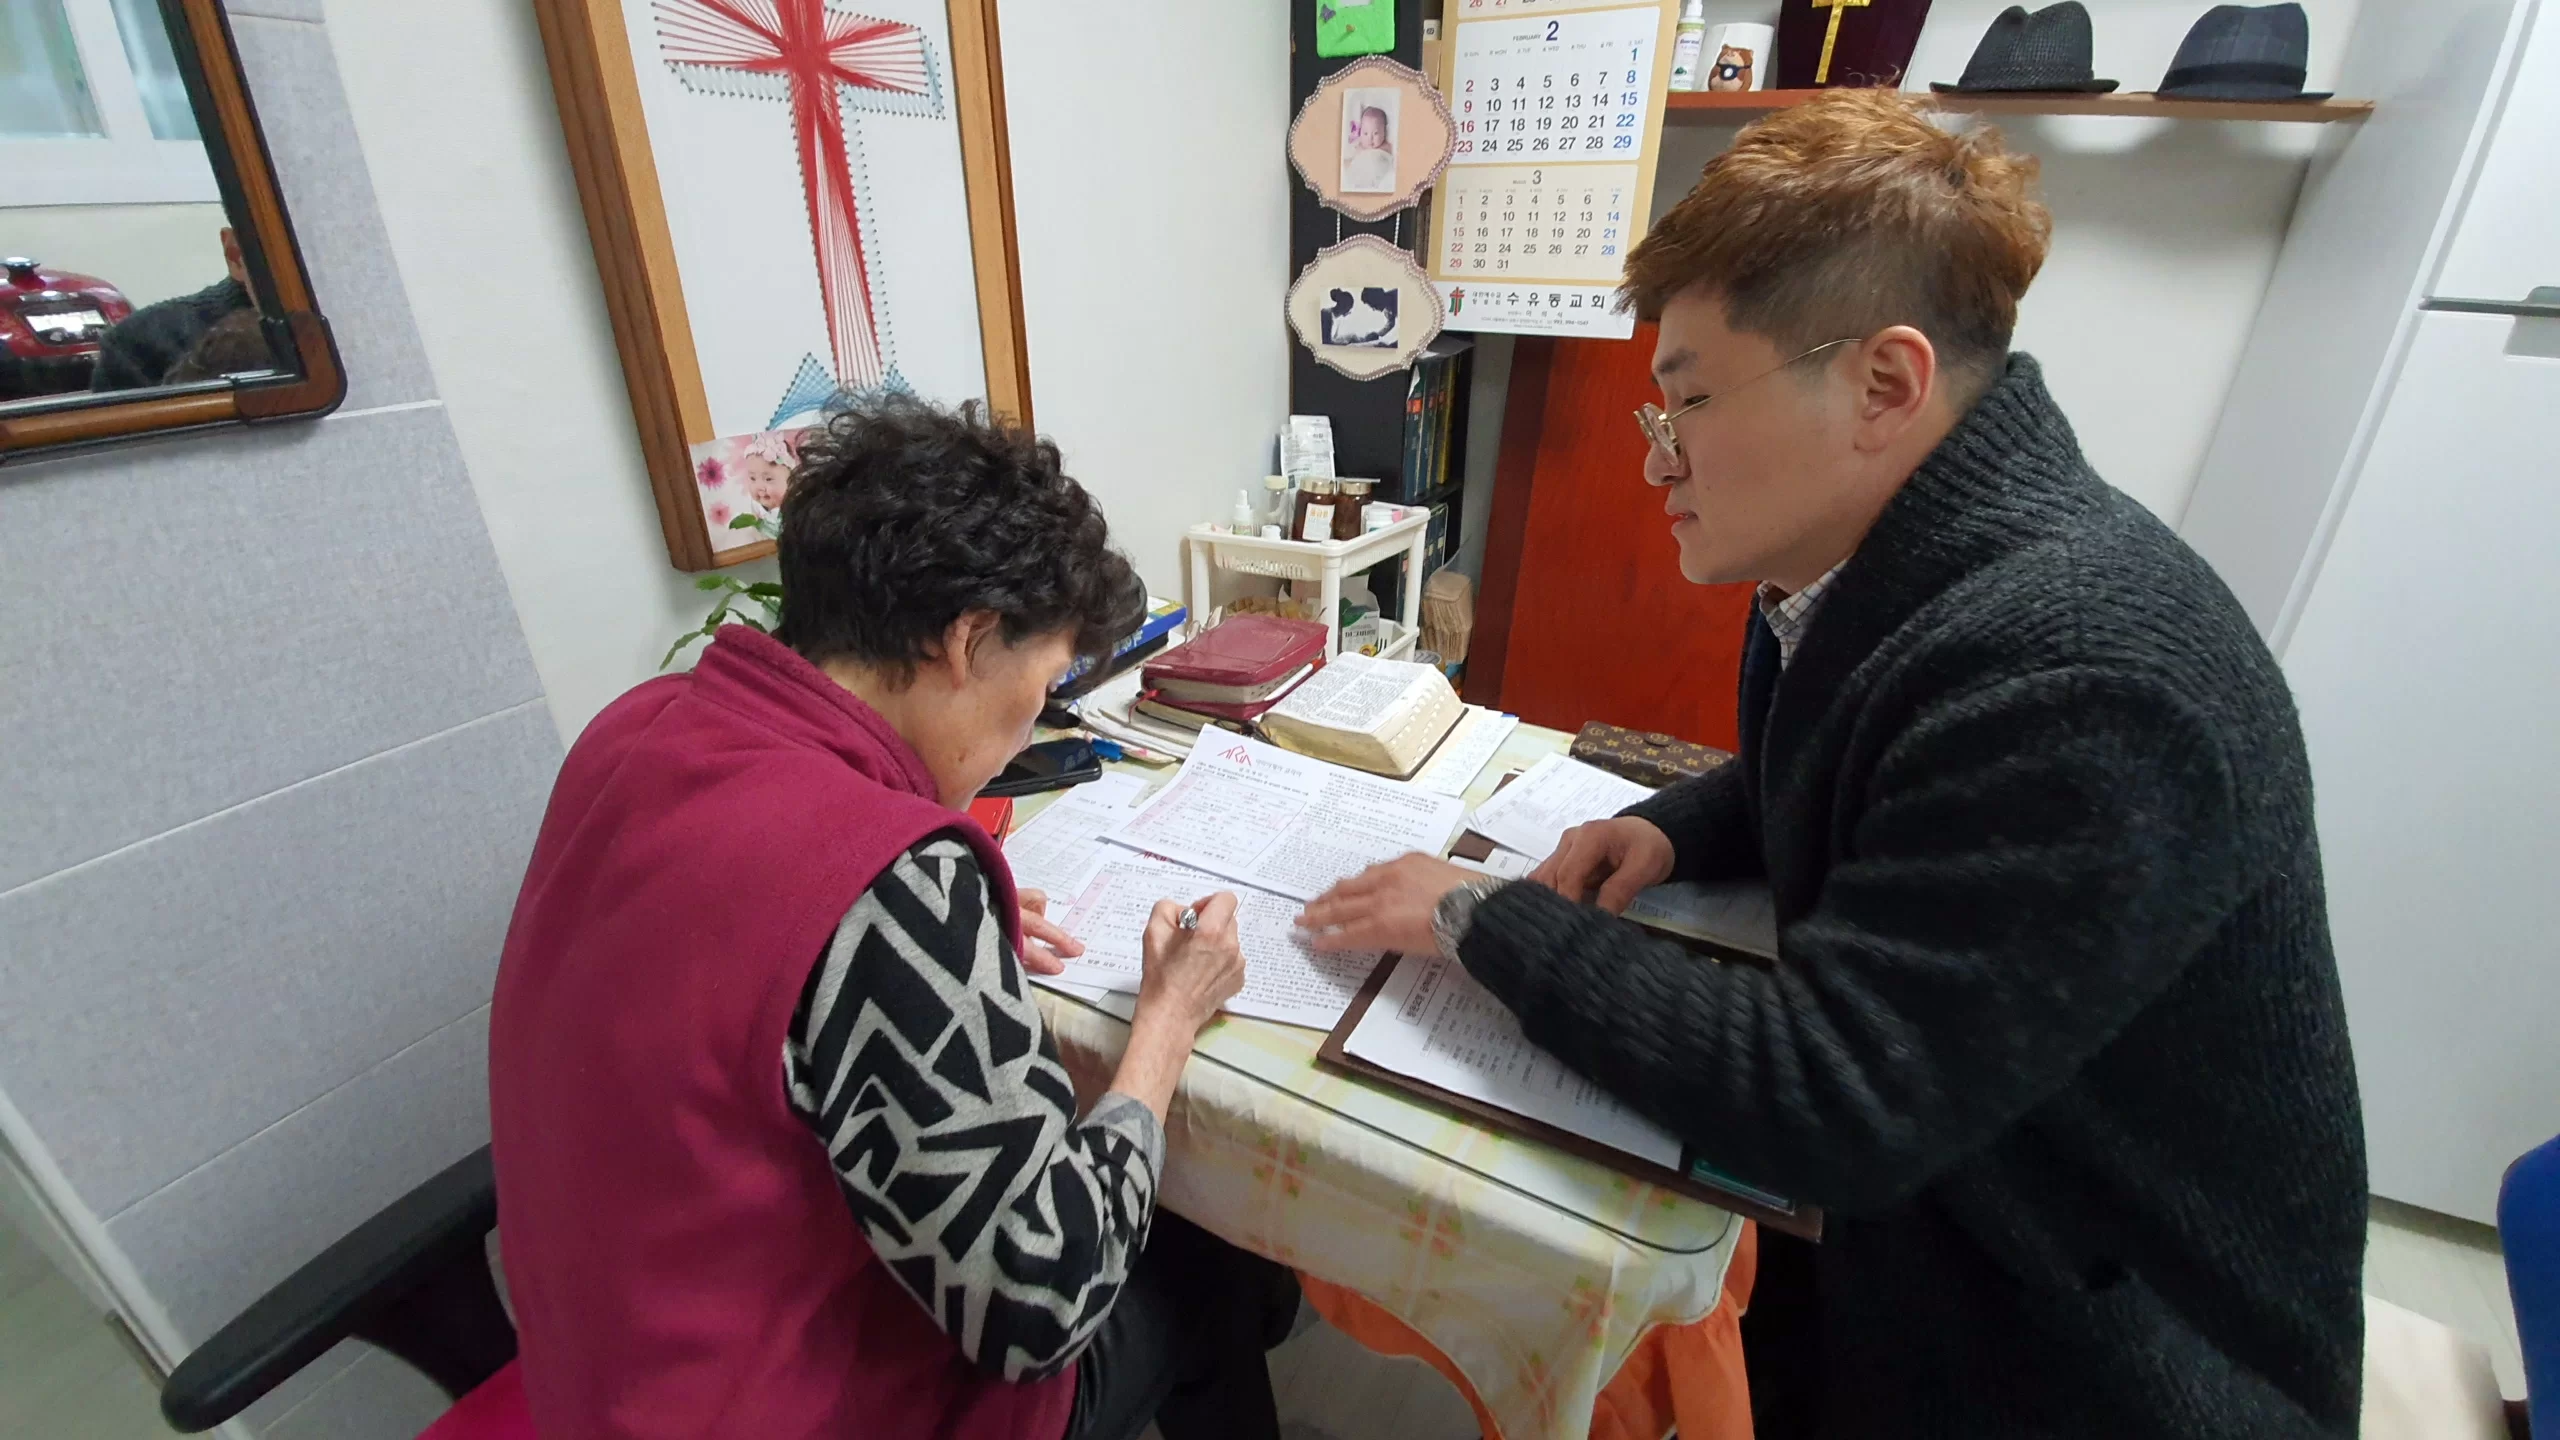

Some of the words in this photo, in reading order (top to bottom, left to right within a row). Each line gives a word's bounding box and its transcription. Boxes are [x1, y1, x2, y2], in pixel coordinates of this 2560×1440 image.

[1545, 20, 1560, 42] 2
[1630, 48, 1638, 60] 1
[1465, 80, 1474, 92] 2
[1490, 78, 1500, 92] 3
[1516, 76, 1525, 90] 4
[1543, 74, 1552, 88] 5
[1570, 72, 1580, 86] 6
[1599, 72, 1608, 86] 7
[1626, 70, 1637, 84] 8
[1464, 100, 1473, 114] 9
[1486, 98, 1502, 112] 10
[1512, 98, 1526, 110] 11
[1538, 96, 1555, 110] 12
[1565, 94, 1582, 108] 13
[1592, 94, 1609, 106] 14
[1620, 92, 1638, 106] 15
[1460, 120, 1475, 132] 16
[1484, 120, 1500, 132] 17
[1510, 118, 1526, 132] 18
[1535, 116, 1552, 130] 19
[1560, 116, 1579, 130] 20
[1587, 114, 1605, 128] 21
[1615, 114, 1635, 128] 22
[1457, 140, 1473, 152] 23
[1481, 140, 1498, 152] 24
[1506, 138, 1524, 152] 25
[1532, 138, 1550, 150] 26
[1558, 136, 1577, 150] 27
[1585, 136, 1604, 150] 28
[1613, 136, 1632, 148] 29
[1532, 170, 1542, 184] 3
[1481, 194, 1489, 206] 2
[1506, 194, 1514, 206] 3
[1531, 194, 1538, 204] 4
[1557, 194, 1565, 206] 5
[1583, 194, 1592, 204] 6
[1612, 194, 1619, 204] 7
[1455, 212, 1464, 222] 8
[1480, 212, 1488, 222] 9
[1503, 212, 1515, 222] 10
[1528, 212, 1539, 220] 11
[1553, 210, 1567, 222] 12
[1580, 212, 1593, 222] 13
[1607, 212, 1620, 222] 14
[1453, 226, 1465, 236] 15
[1477, 228, 1489, 238] 16
[1501, 228, 1514, 238] 17
[1526, 228, 1539, 238] 18
[1552, 228, 1565, 238] 19
[1576, 228, 1591, 238] 20
[1603, 228, 1617, 238] 21
[1450, 242, 1464, 252] 22
[1474, 242, 1487, 254] 23
[1498, 244, 1512, 254] 24
[1523, 244, 1537, 254] 25
[1548, 244, 1562, 254] 26
[1574, 244, 1589, 254] 27
[1600, 244, 1616, 256] 28
[1449, 258, 1463, 268] 29
[1472, 258, 1486, 268] 30
[1496, 260, 1509, 268] 31
[1506, 292, 1605, 309] 수유동교회
